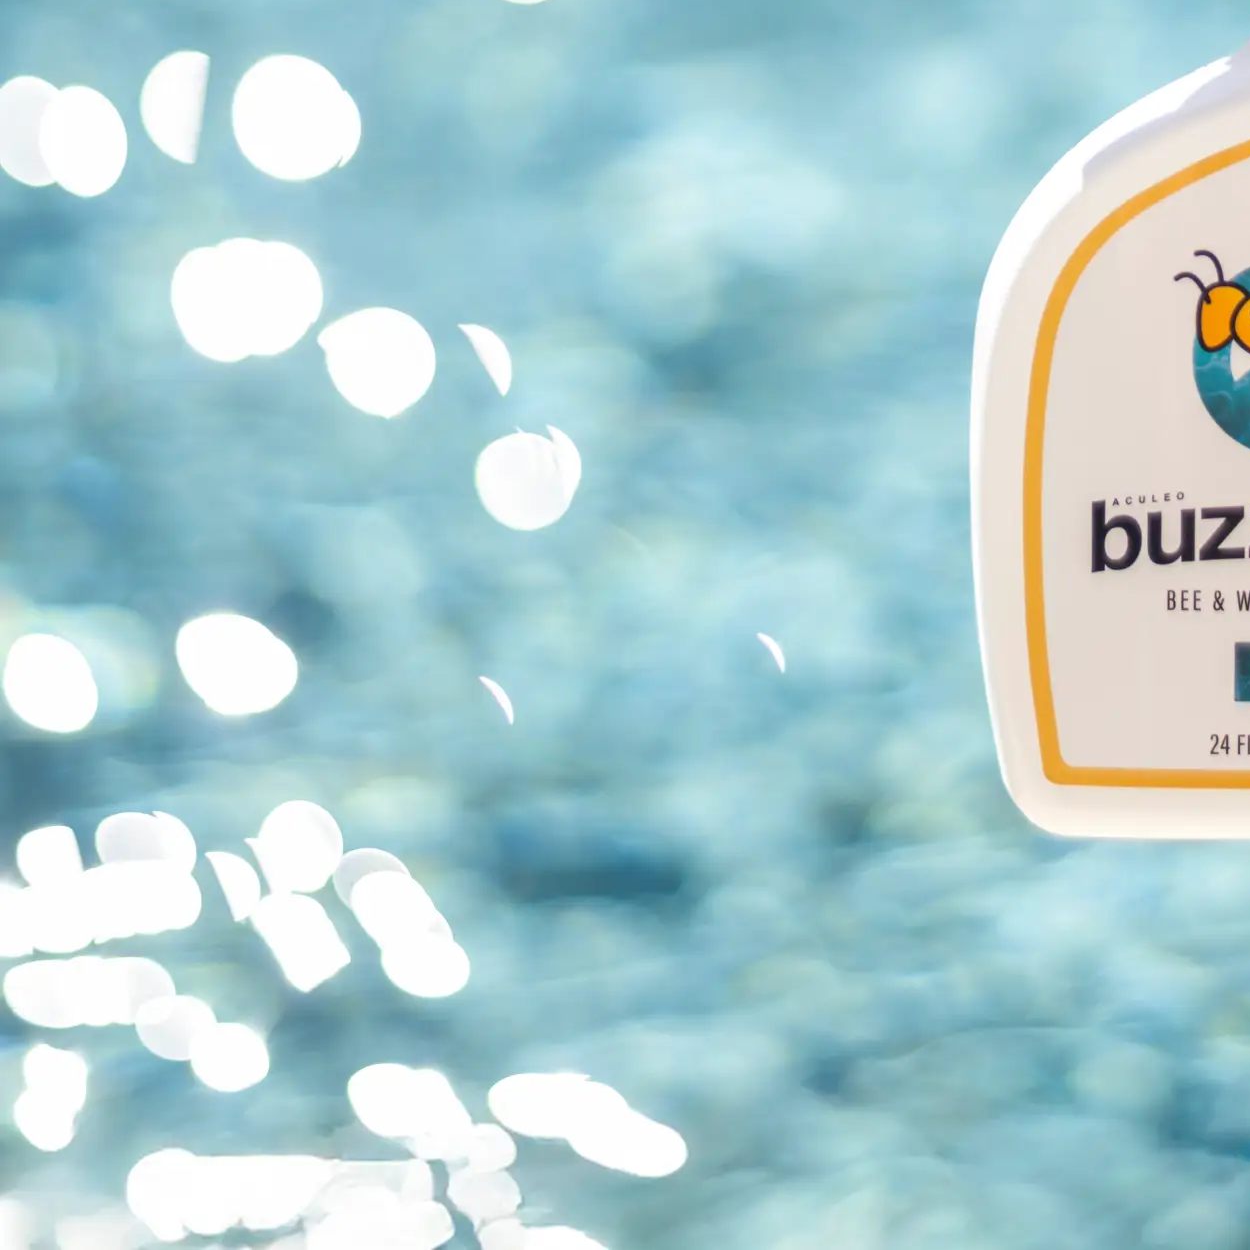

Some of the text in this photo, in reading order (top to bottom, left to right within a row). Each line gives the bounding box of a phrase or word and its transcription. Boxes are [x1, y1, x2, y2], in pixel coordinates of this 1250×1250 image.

[1112, 491, 1186, 507] ACULEO
[1166, 590, 1202, 612] BEE
[1212, 590, 1226, 612] &
[1209, 734, 1231, 756] 24
